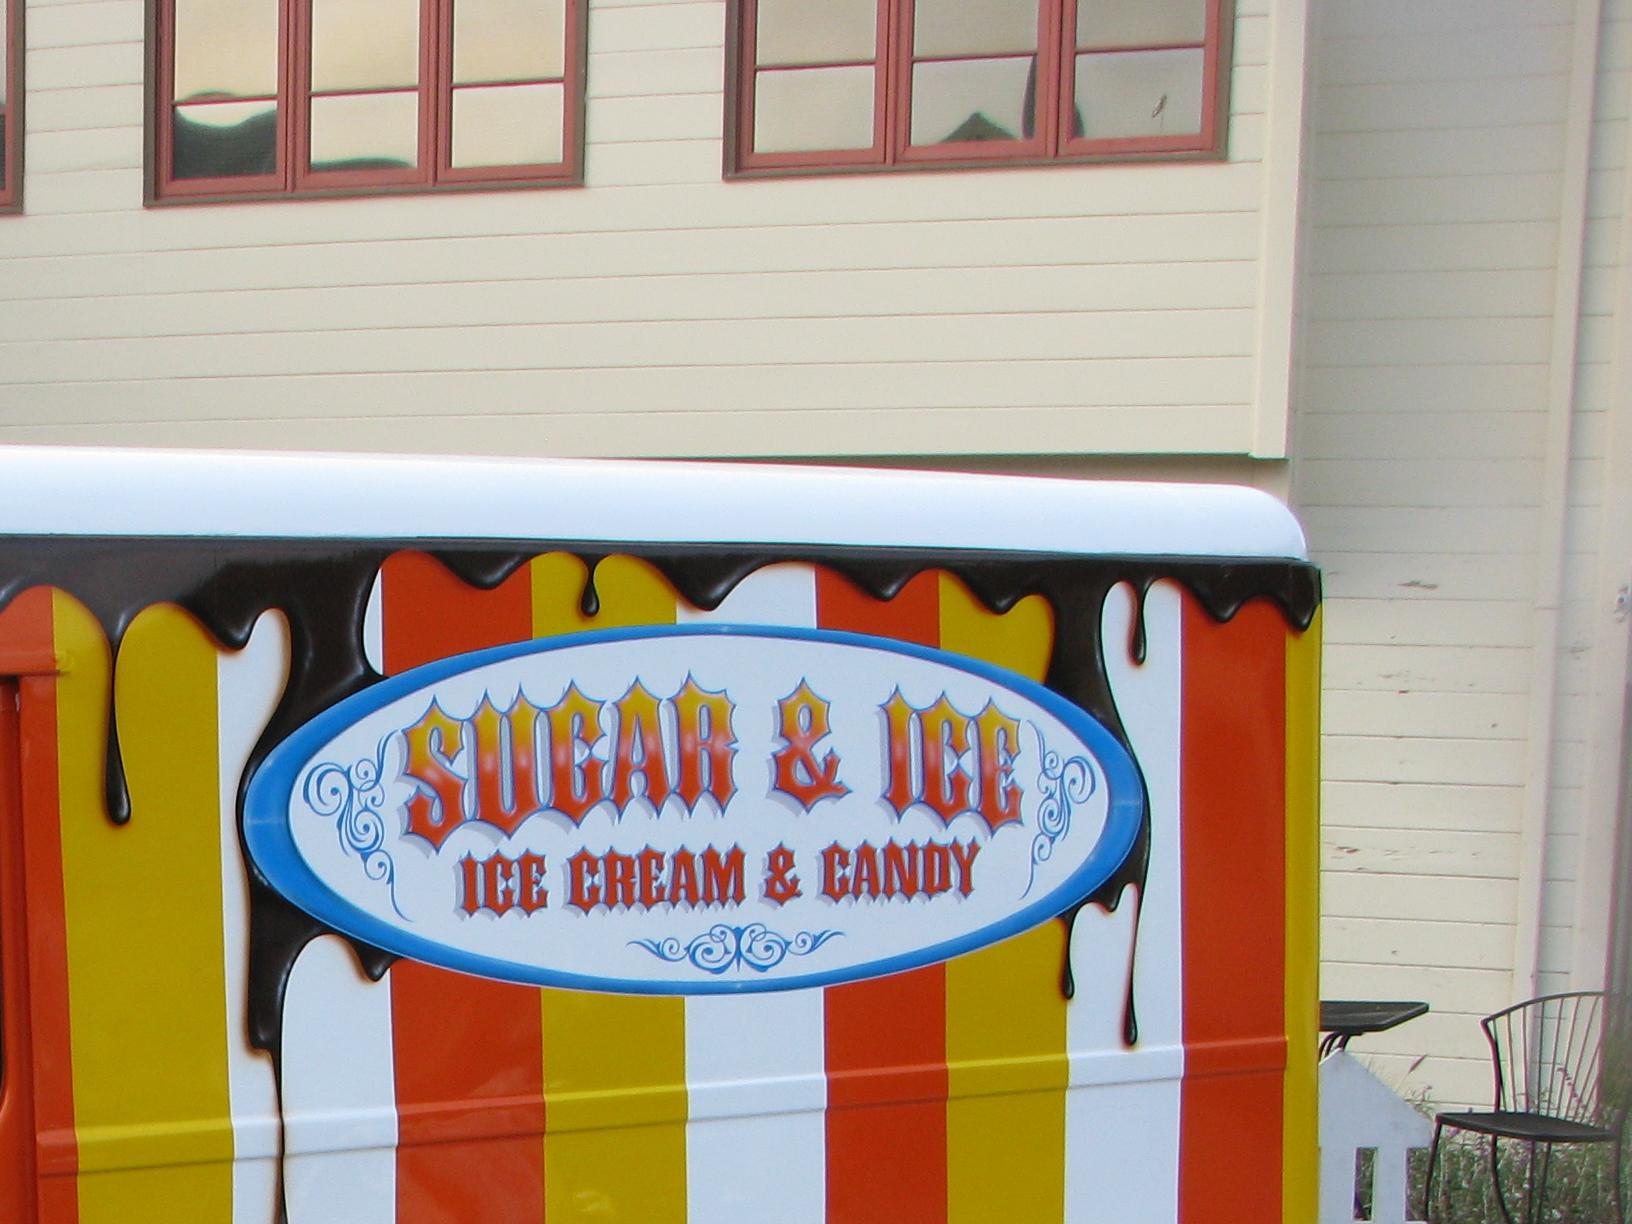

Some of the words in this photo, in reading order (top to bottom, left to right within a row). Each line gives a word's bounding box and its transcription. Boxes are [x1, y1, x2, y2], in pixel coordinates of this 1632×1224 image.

[396, 669, 739, 856] SUGAR
[770, 676, 853, 814] &
[876, 683, 1025, 839] ICE
[458, 848, 548, 919] ICE
[565, 842, 747, 918] CREAM
[762, 840, 804, 907] &
[821, 836, 982, 906] CANDY
